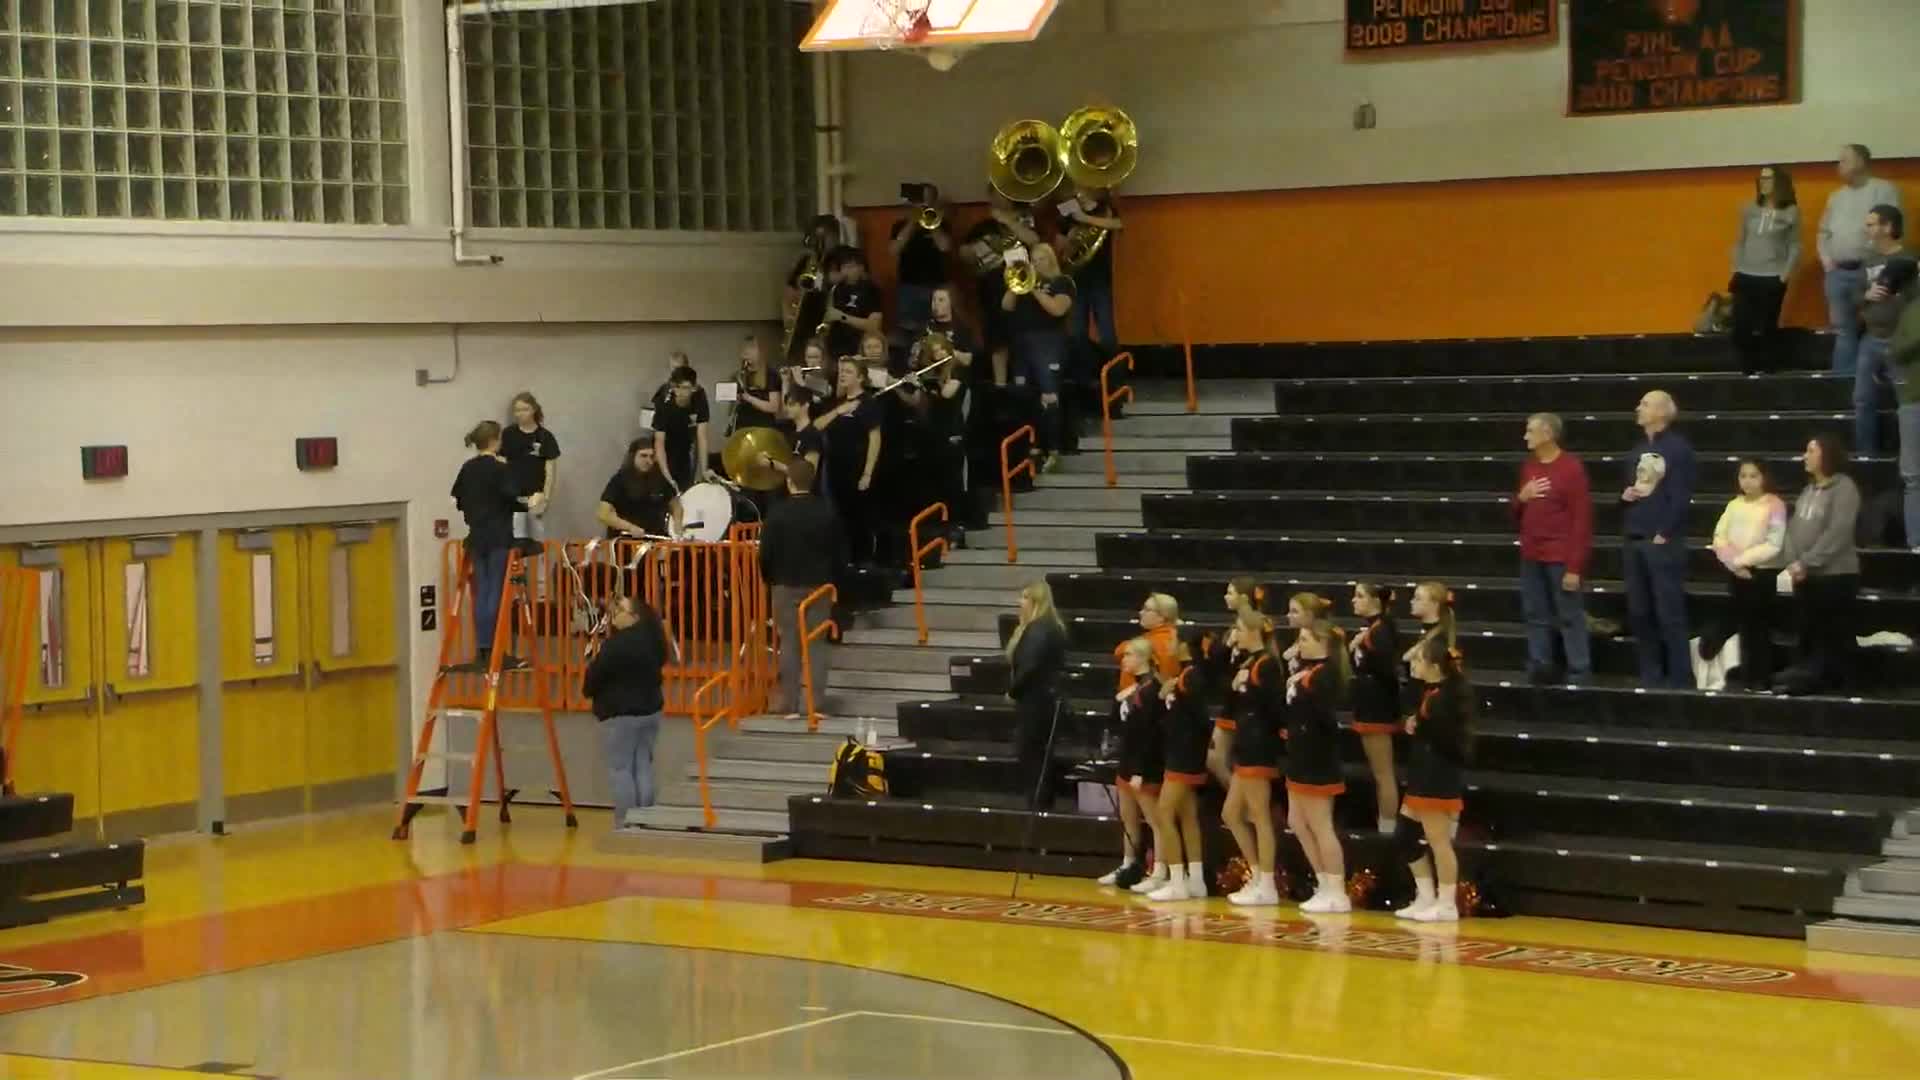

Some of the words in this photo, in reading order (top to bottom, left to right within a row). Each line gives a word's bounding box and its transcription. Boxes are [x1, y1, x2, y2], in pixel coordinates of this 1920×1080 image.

[1423, 9, 1546, 41] CHAMPIONS
[1714, 48, 1762, 75] CUP
[1650, 73, 1780, 105] CHAMPIONS
